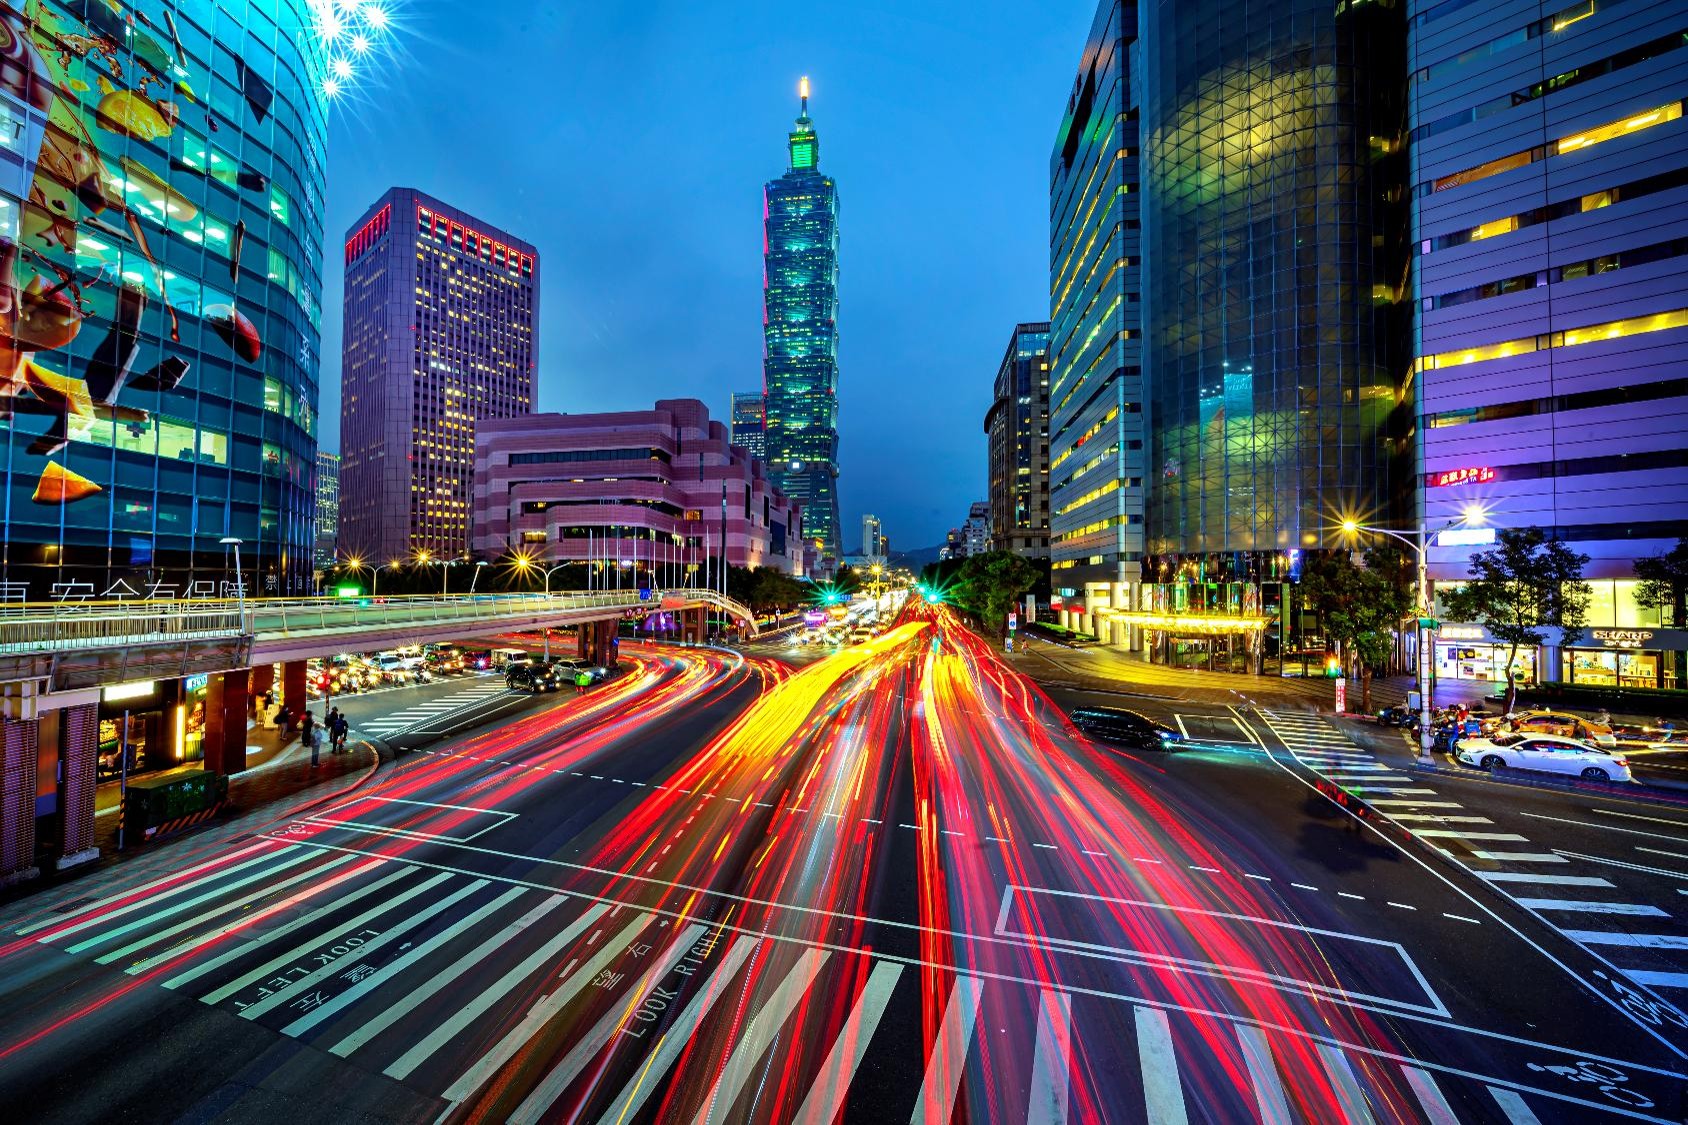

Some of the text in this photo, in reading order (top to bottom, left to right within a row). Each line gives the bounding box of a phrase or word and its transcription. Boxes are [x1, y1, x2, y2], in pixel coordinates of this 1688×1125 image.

[50, 577, 249, 614] 安全有保障
[1593, 630, 1653, 640] SHARP
[234, 929, 380, 1011] LOOK LEFT
[620, 929, 725, 1038] LOOK RIGHT
